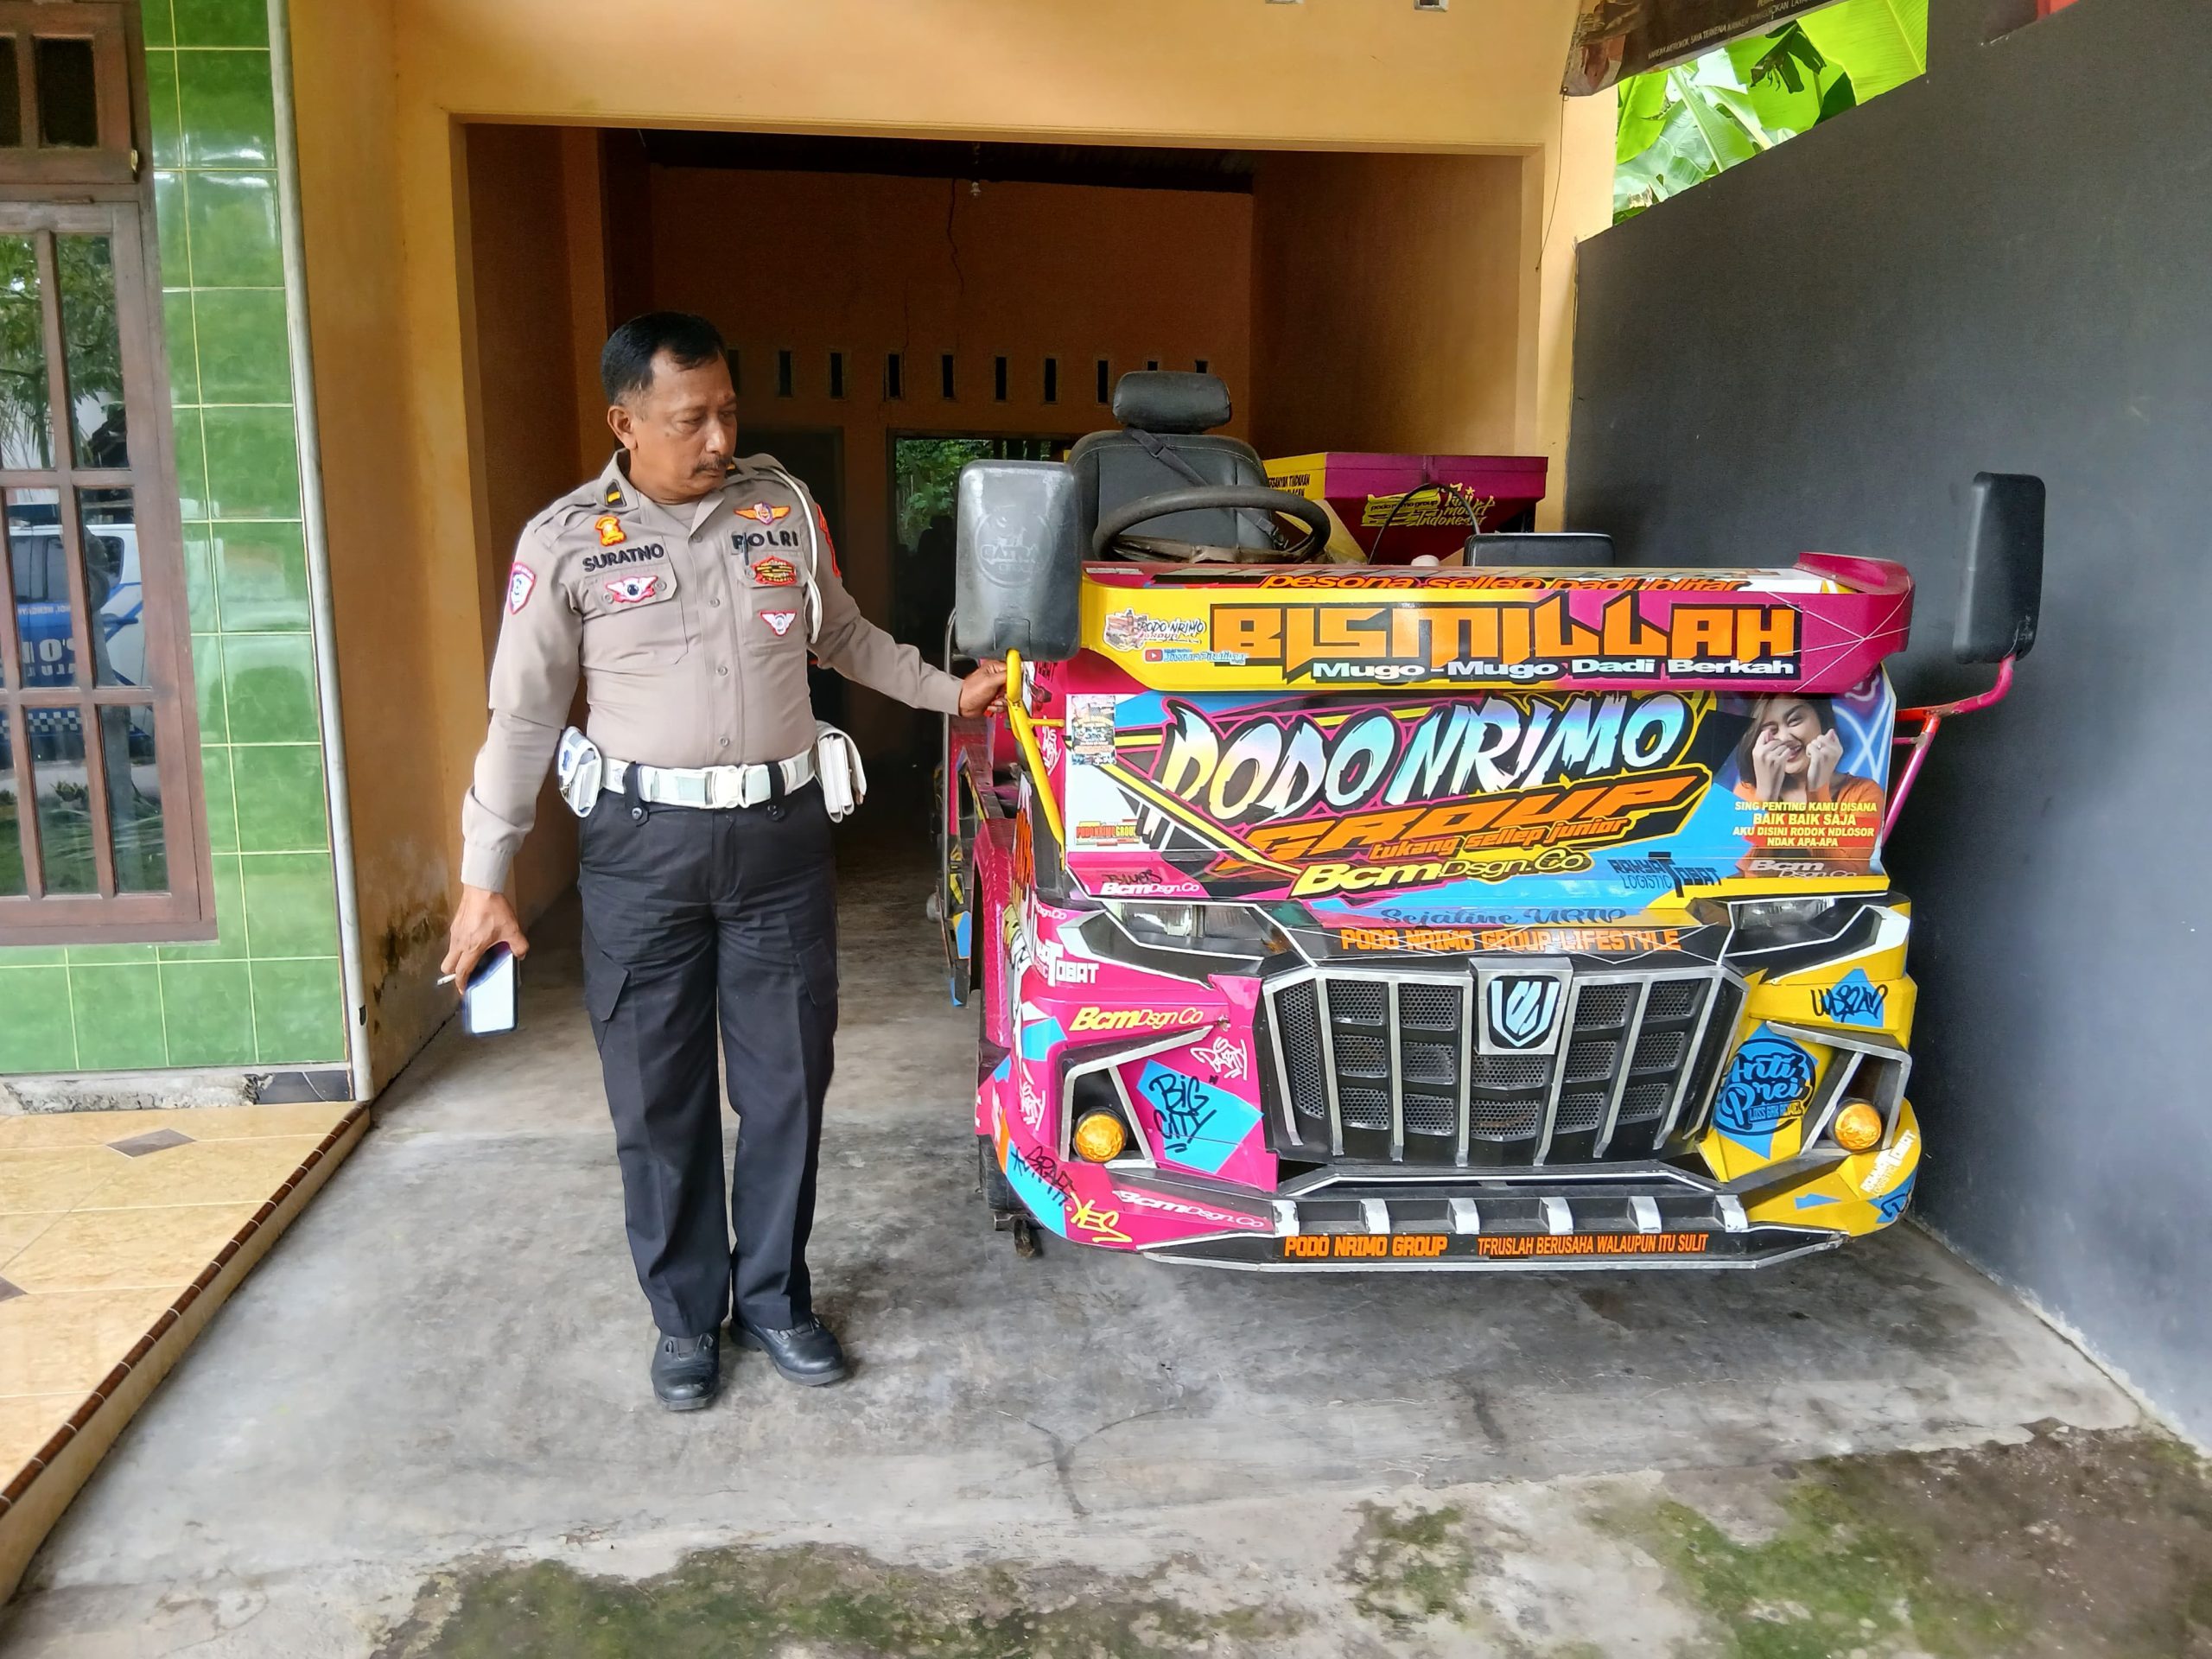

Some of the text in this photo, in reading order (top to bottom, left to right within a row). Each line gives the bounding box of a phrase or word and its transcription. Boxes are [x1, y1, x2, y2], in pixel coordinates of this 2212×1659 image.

[731, 530, 799, 550] POLRI
[582, 543, 664, 573] SURATNO
[1211, 594, 1796, 673] BISMILLAH
[1571, 658, 1656, 674] Dadi
[1668, 658, 1795, 675] Berkah
[1384, 694, 1685, 805] NRIMO
[1734, 801, 1878, 812] SING PENTING KAMU DISANA
[1752, 813, 1857, 826] BAIK BAIK SAJA
[1370, 817, 1630, 861] tukang sellep junior
[1732, 826, 1875, 837] AKU DISINI RODOK NDLOSOR
[1767, 836, 1839, 848] NDAK APA-APA
[1620, 874, 1673, 889] LOGISTIC
[1341, 929, 1398, 950] PODO
[1404, 929, 1474, 950] NRIMO
[1284, 1236, 1448, 1257] PODO NRIMO GROUP
[1535, 1236, 1594, 1255] BERUSAHA
[1597, 1236, 1656, 1254] WALAUPUN
[1657, 1235, 1676, 1253] ITU
[1677, 1234, 1710, 1252] SULIT
